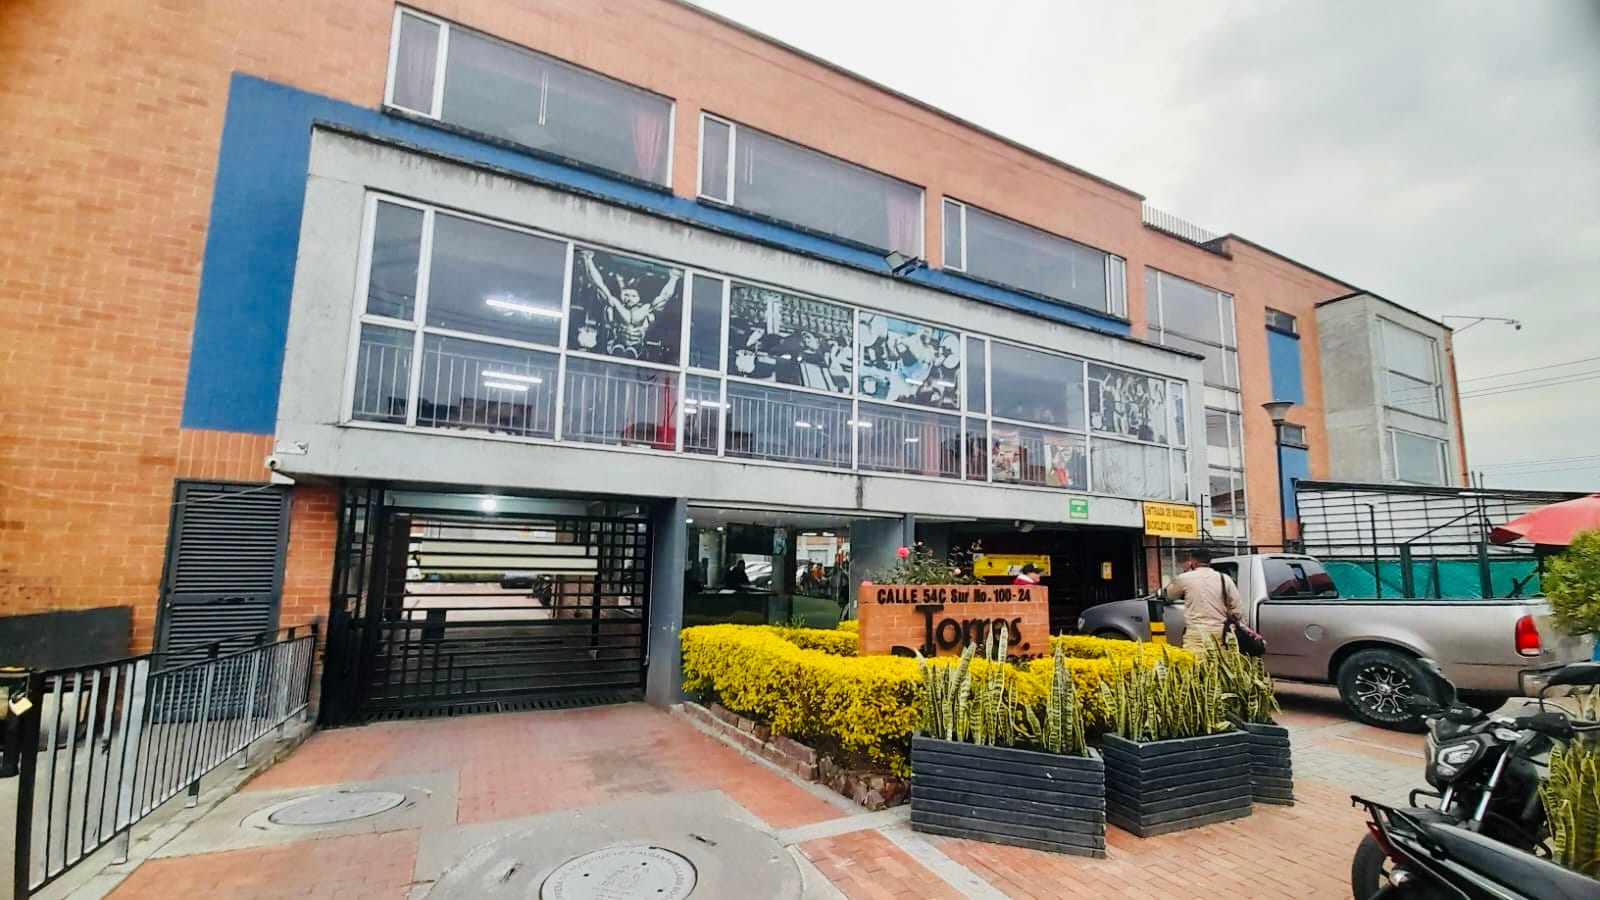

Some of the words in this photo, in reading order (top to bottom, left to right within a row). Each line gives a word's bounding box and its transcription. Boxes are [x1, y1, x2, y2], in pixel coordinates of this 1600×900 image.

[877, 588, 918, 605] CALLE
[923, 588, 947, 604] 54C
[951, 588, 970, 603] Sur
[974, 588, 992, 603] No.
